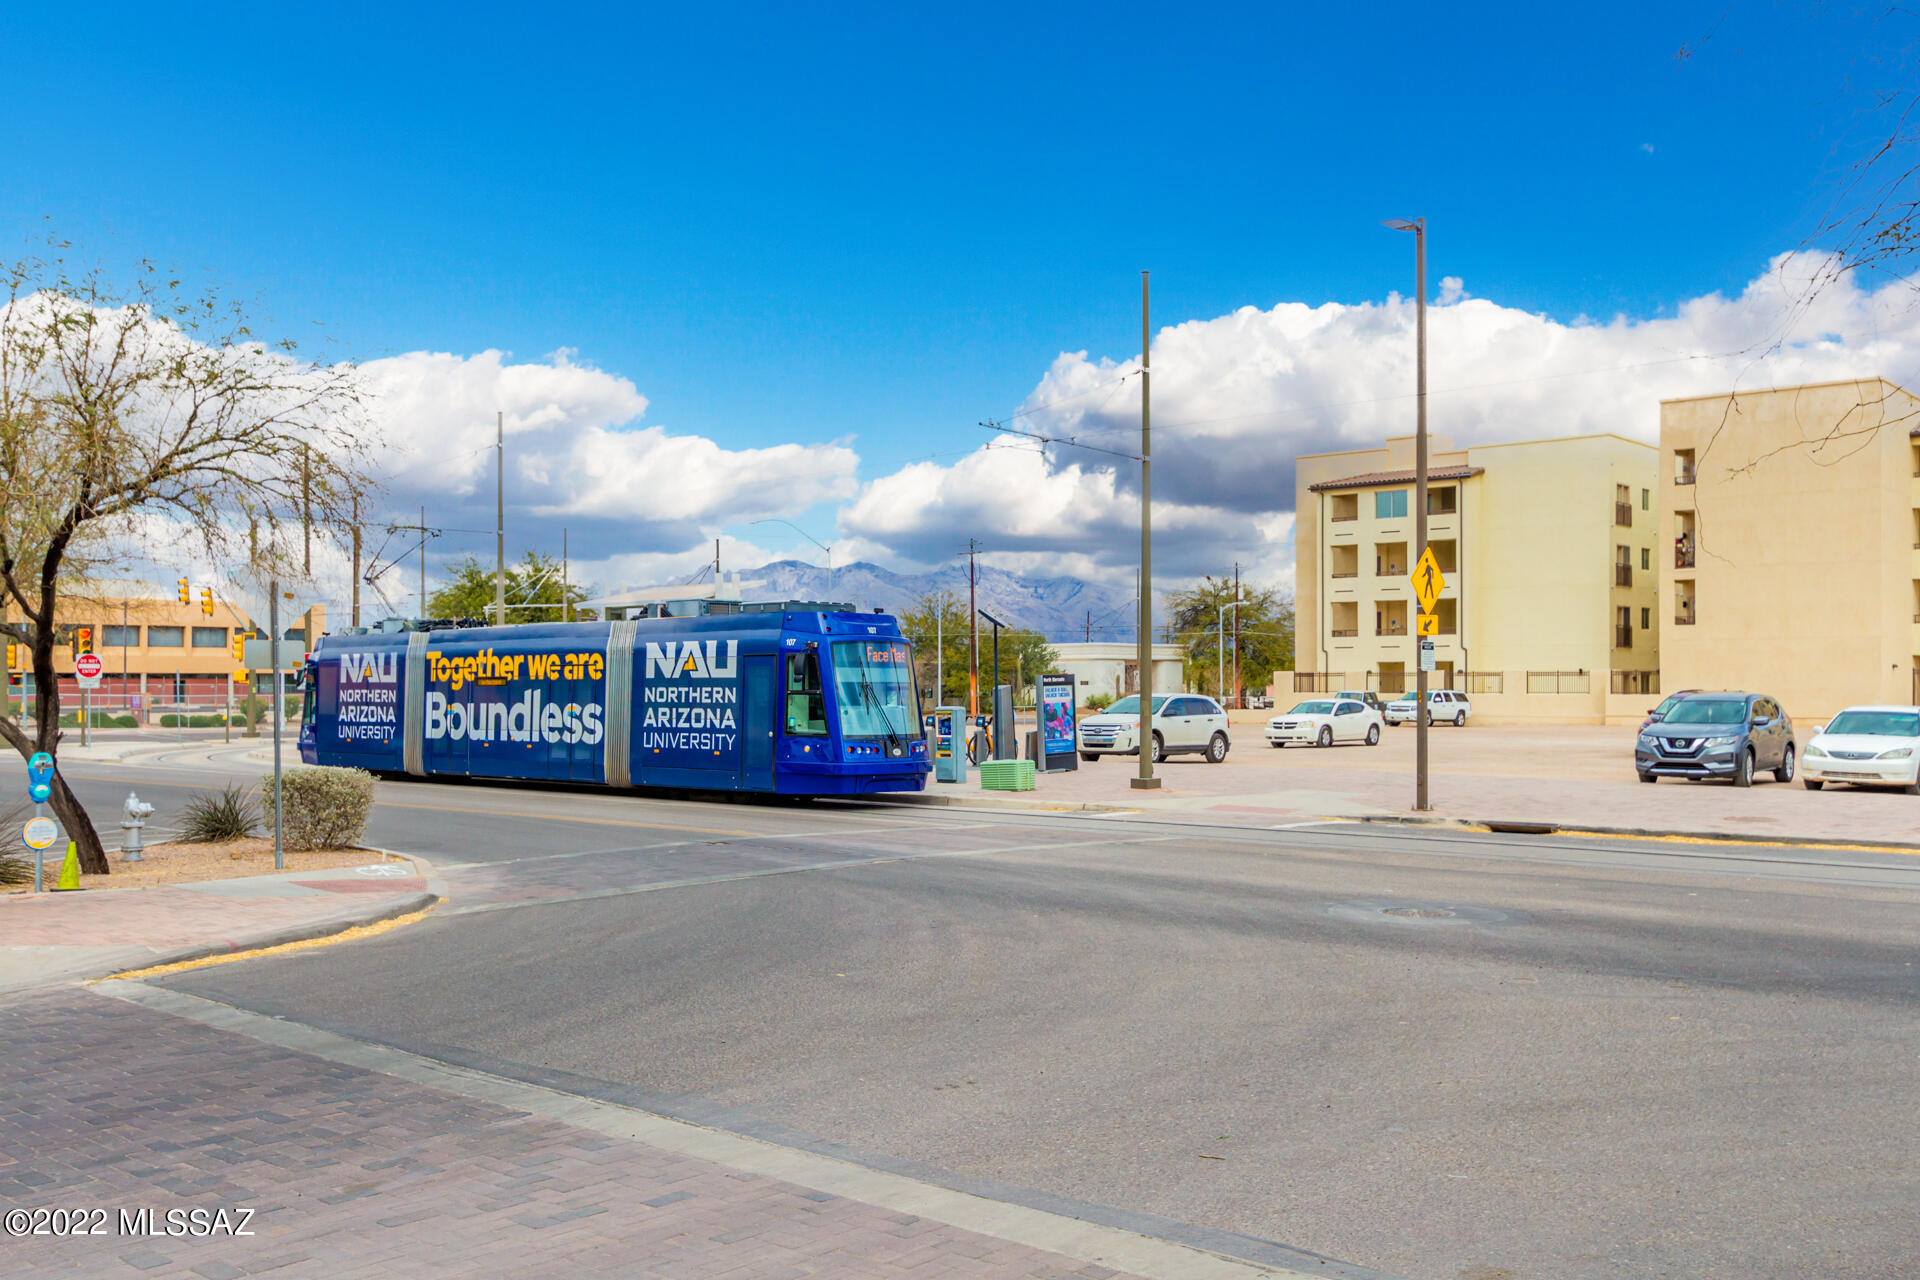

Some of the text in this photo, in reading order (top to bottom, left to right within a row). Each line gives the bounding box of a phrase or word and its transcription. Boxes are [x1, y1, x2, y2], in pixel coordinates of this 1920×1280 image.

[785, 638, 797, 646] 107
[645, 639, 739, 679] NAU
[866, 646, 889, 662] Face
[339, 651, 397, 684] NAU
[426, 647, 604, 691] Together we are
[339, 689, 396, 703] NORTHERN
[644, 686, 737, 704] NORTHERN
[338, 705, 396, 723] ARIZONA
[425, 688, 604, 745] Boundless
[643, 707, 737, 729] ARIZONA
[338, 724, 396, 741] UNIVERSITY
[643, 731, 737, 751] UNIVERSITY
